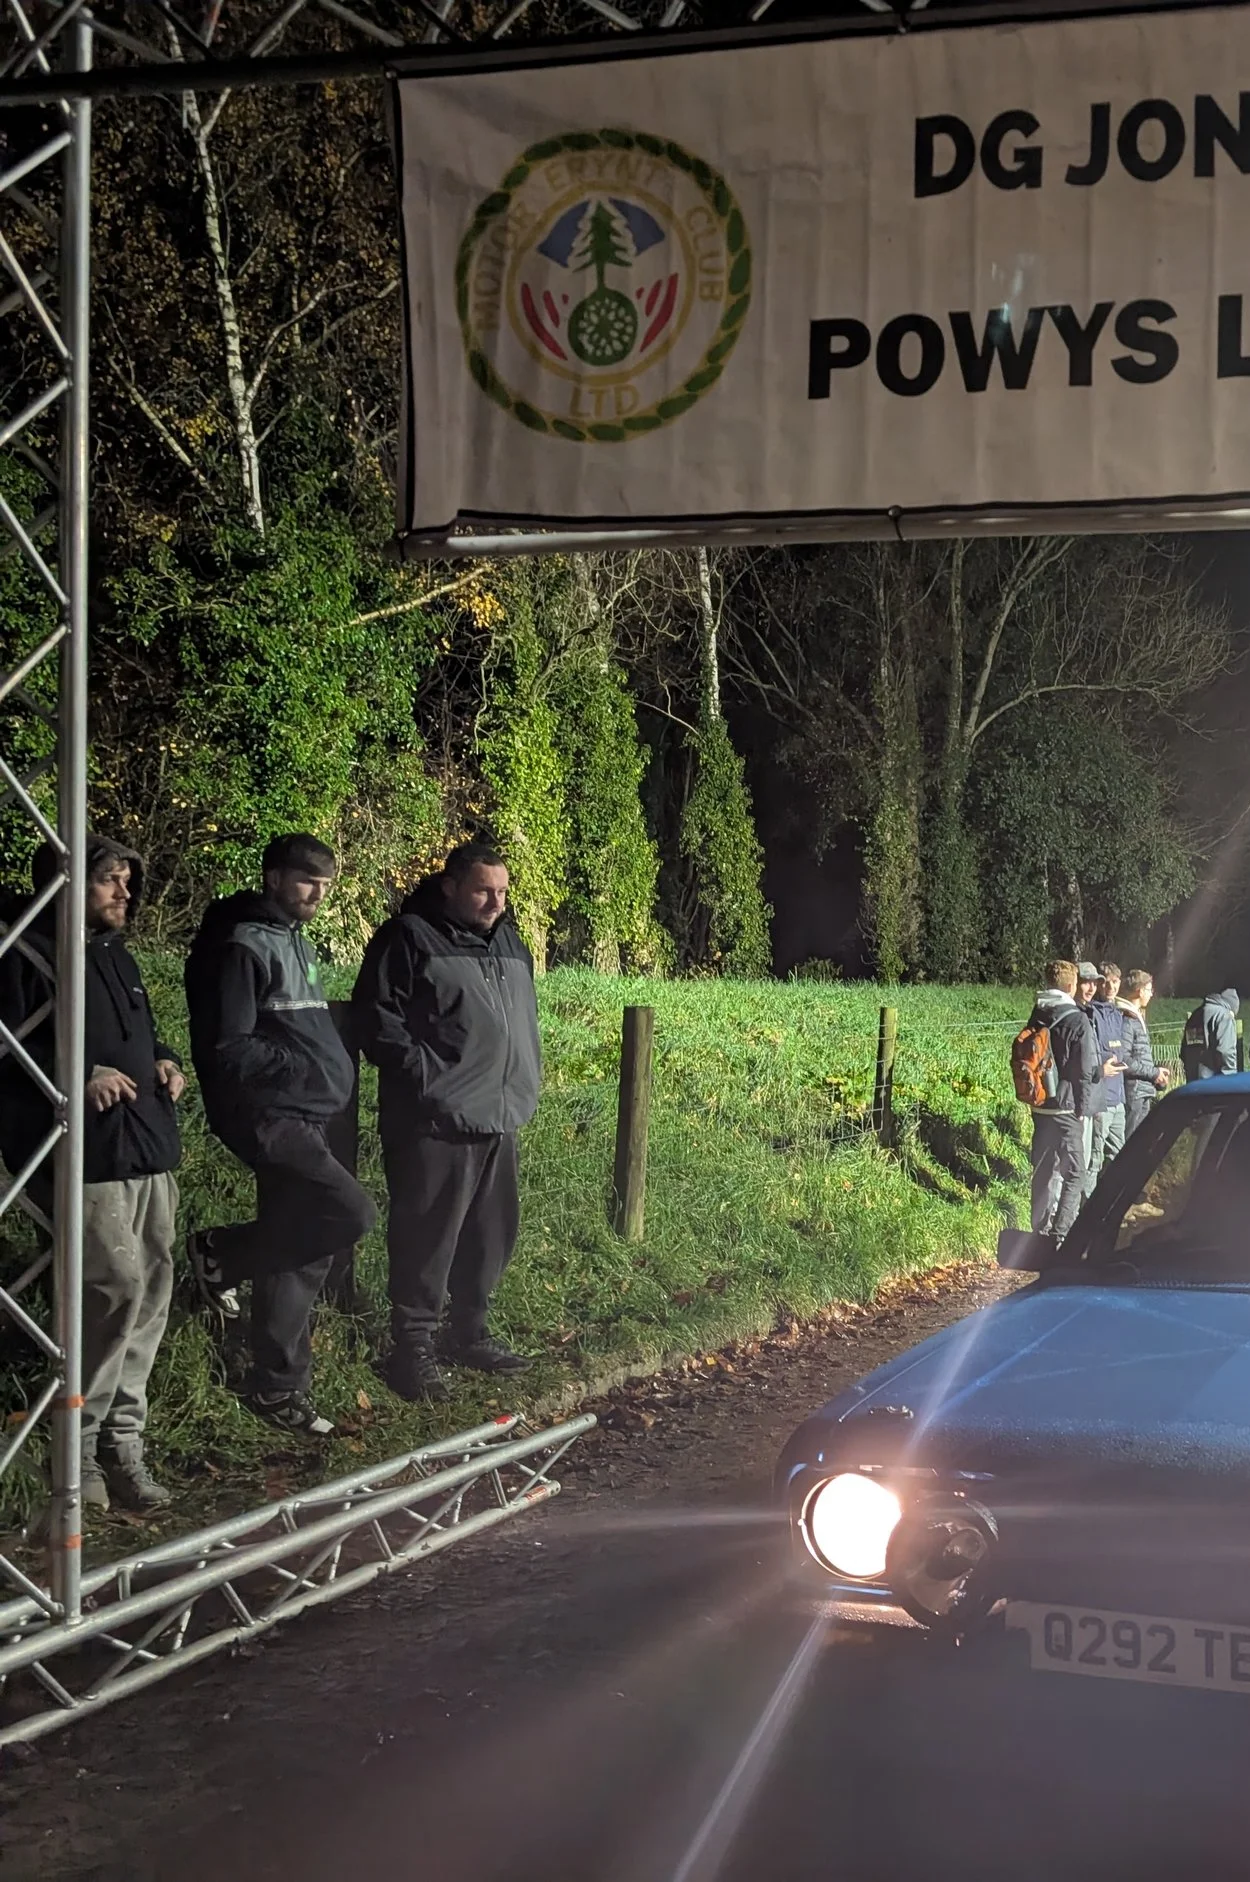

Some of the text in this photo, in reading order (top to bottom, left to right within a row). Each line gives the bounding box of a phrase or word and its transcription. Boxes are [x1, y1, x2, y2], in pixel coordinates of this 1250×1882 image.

[914, 109, 1043, 198] DG
[471, 201, 536, 332] MOTOR
[685, 205, 726, 303] CLUB
[808, 299, 1179, 399] POWYS
[568, 384, 643, 419] LTD
[1044, 1611, 1176, 1674] Q292
